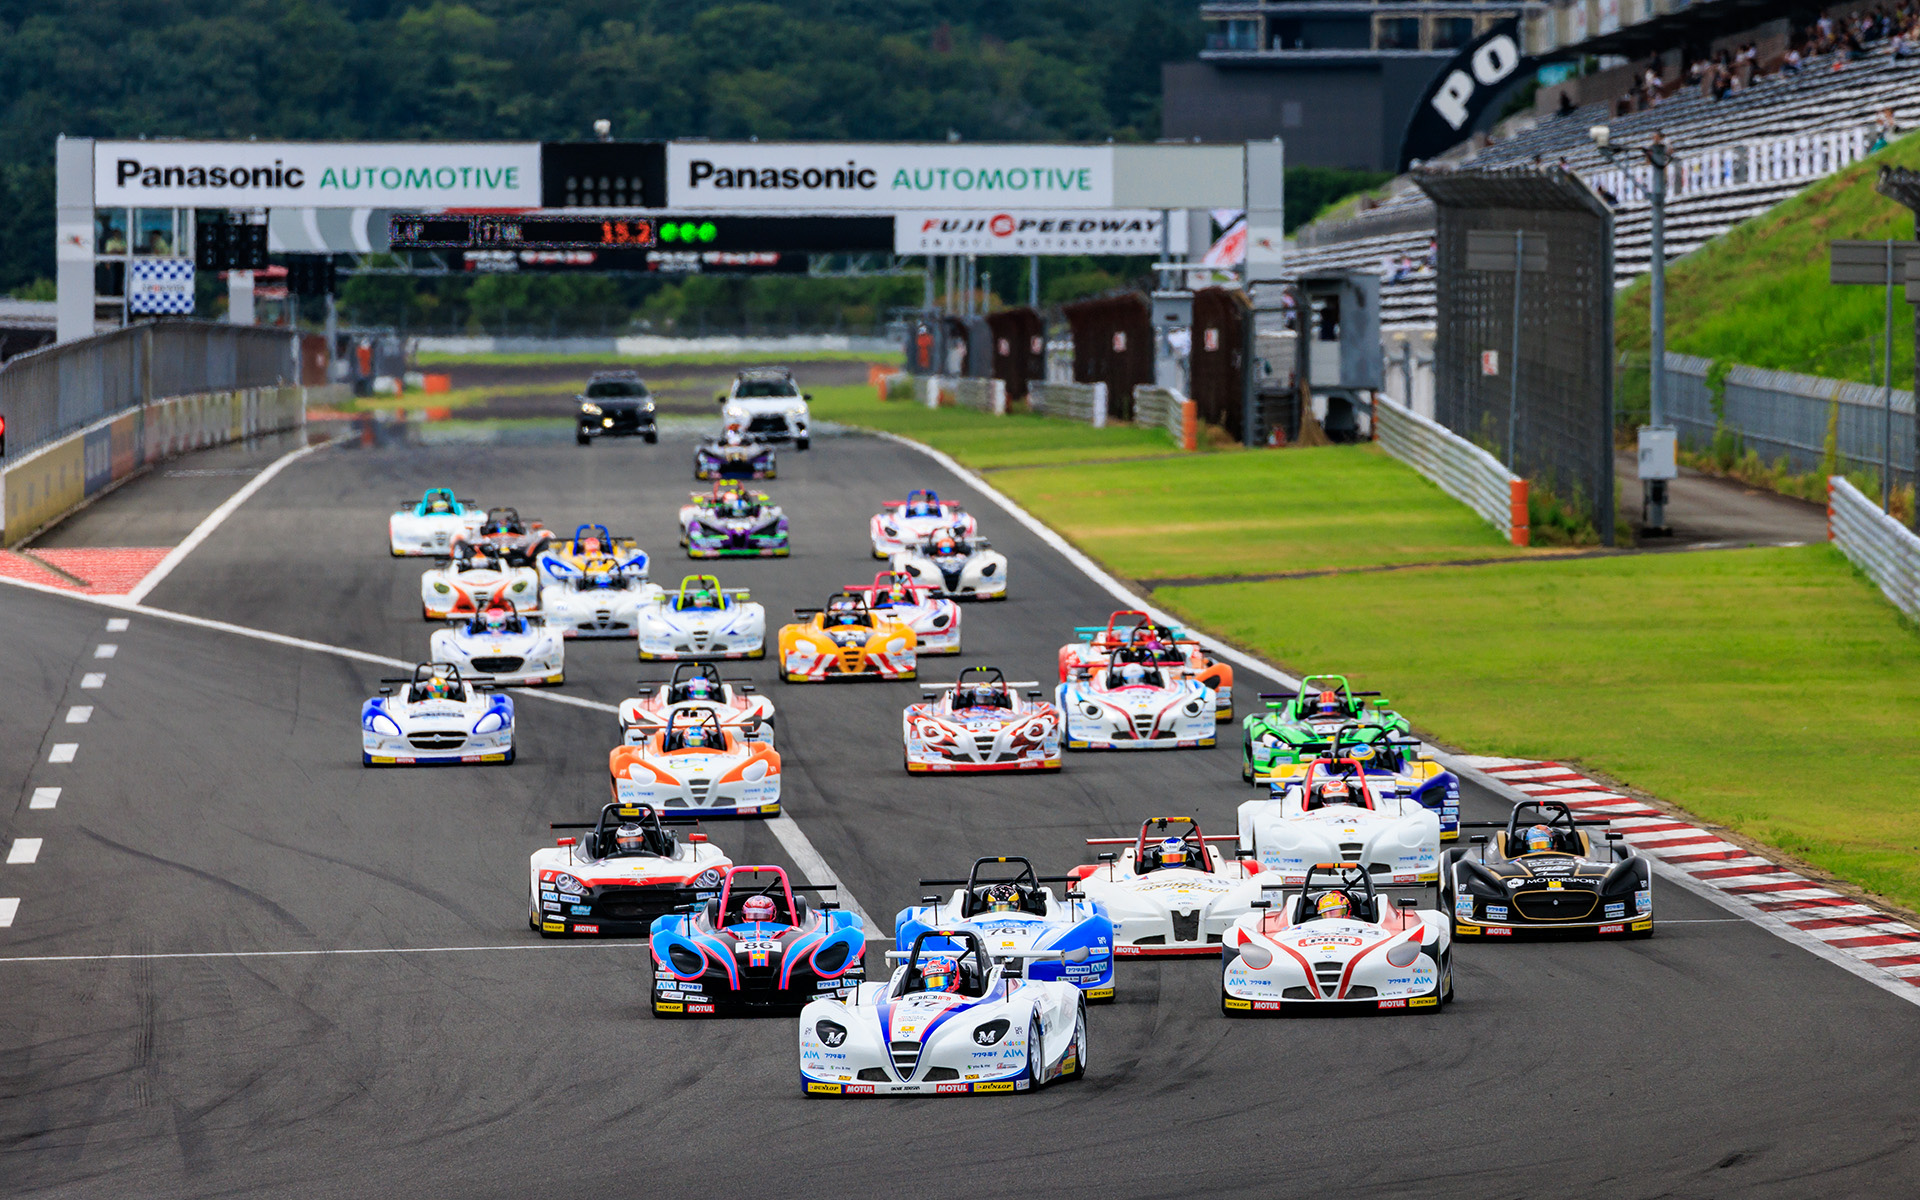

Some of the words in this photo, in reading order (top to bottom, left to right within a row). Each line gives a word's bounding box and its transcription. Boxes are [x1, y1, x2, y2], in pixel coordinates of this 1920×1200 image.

[117, 158, 305, 188] Panasonic
[320, 166, 520, 190] AUTOMOTIVE
[690, 159, 877, 189] Panasonic
[891, 167, 1093, 191] AUTOMOTIVE
[921, 219, 986, 233] FUJI
[1527, 877, 1601, 885] MOTORSPORT
[744, 942, 774, 950] 86
[1229, 978, 1246, 986] AIM
[1413, 976, 1432, 984] AIM
[658, 981, 675, 989] AIM
[689, 1004, 713, 1012] MOTUL
[803, 1050, 820, 1059] AIM
[1003, 1049, 1024, 1058] AIM
[846, 1085, 874, 1093] MOTUL
[938, 1084, 968, 1093] MOTUL
